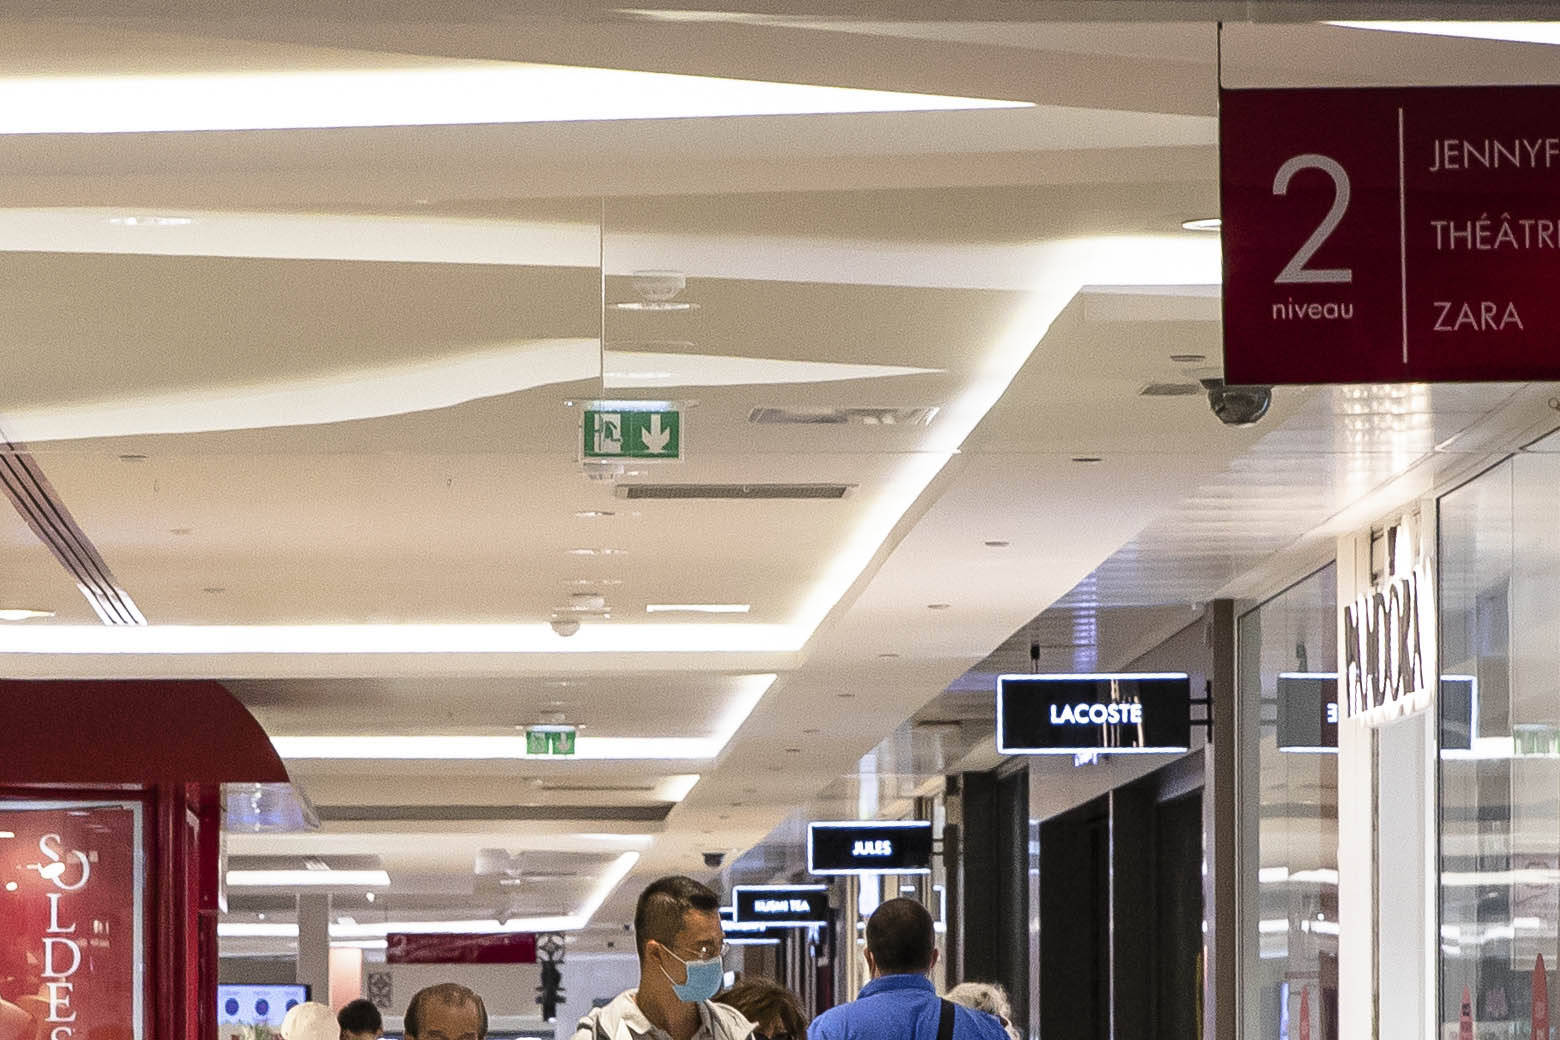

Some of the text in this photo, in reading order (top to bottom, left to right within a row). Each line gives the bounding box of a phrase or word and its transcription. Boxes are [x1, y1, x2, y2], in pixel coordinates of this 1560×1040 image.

[1429, 137, 1559, 173] JENNYF
[1272, 153, 1352, 284] 2
[1430, 211, 1560, 251] THÉÂTR
[1272, 297, 1354, 321] niveau
[1432, 301, 1524, 332] ZARA
[1049, 702, 1144, 725] LACOSTE
[851, 839, 893, 856] JULES
